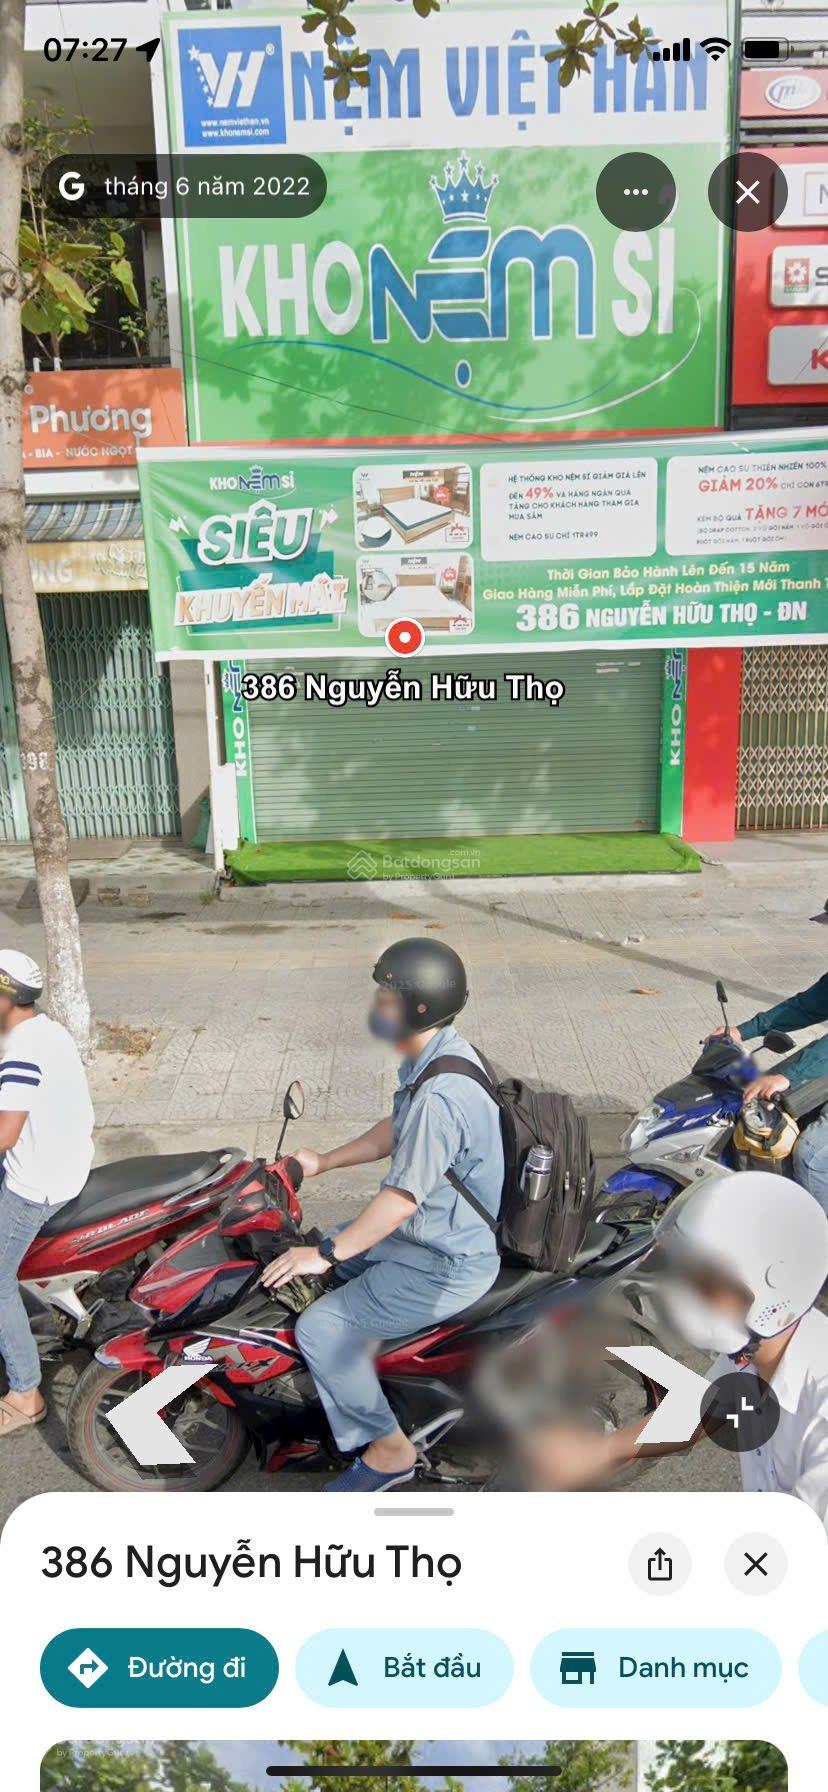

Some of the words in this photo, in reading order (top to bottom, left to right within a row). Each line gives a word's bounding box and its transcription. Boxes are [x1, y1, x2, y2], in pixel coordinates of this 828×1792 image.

[446, 30, 568, 131] VIỆT
[30, 404, 152, 439] Phương
[806, 461, 827, 470] 100%
[525, 487, 554, 499] 49%
[698, 475, 741, 492] GIẢM
[745, 476, 778, 491] 20%
[745, 505, 787, 523] TẶNG
[793, 506, 802, 519] 7
[202, 506, 308, 562] SIÊU
[547, 568, 574, 580] Thời
[578, 567, 609, 580] Gian
[613, 565, 639, 579] Bảo
[643, 565, 678, 578] Hành
[682, 563, 705, 576] Lên
[709, 561, 735, 575] Đến
[739, 562, 756, 574] 15
[759, 561, 790, 573] Năm
[178, 575, 284, 623] KHUYẾN
[482, 588, 514, 600] Giao
[518, 587, 553, 601] Hàng
[648, 582, 672, 597] Đặt
[675, 581, 710, 594] Hoàn
[714, 580, 749, 595] Thiện
[781, 578, 821, 591] Thanh
[516, 603, 580, 632] 386
[586, 599, 667, 628] NGUYỄN
[673, 601, 714, 625] HỮU
[719, 602, 758, 627] THỌ
[777, 601, 808, 622] ĐN
